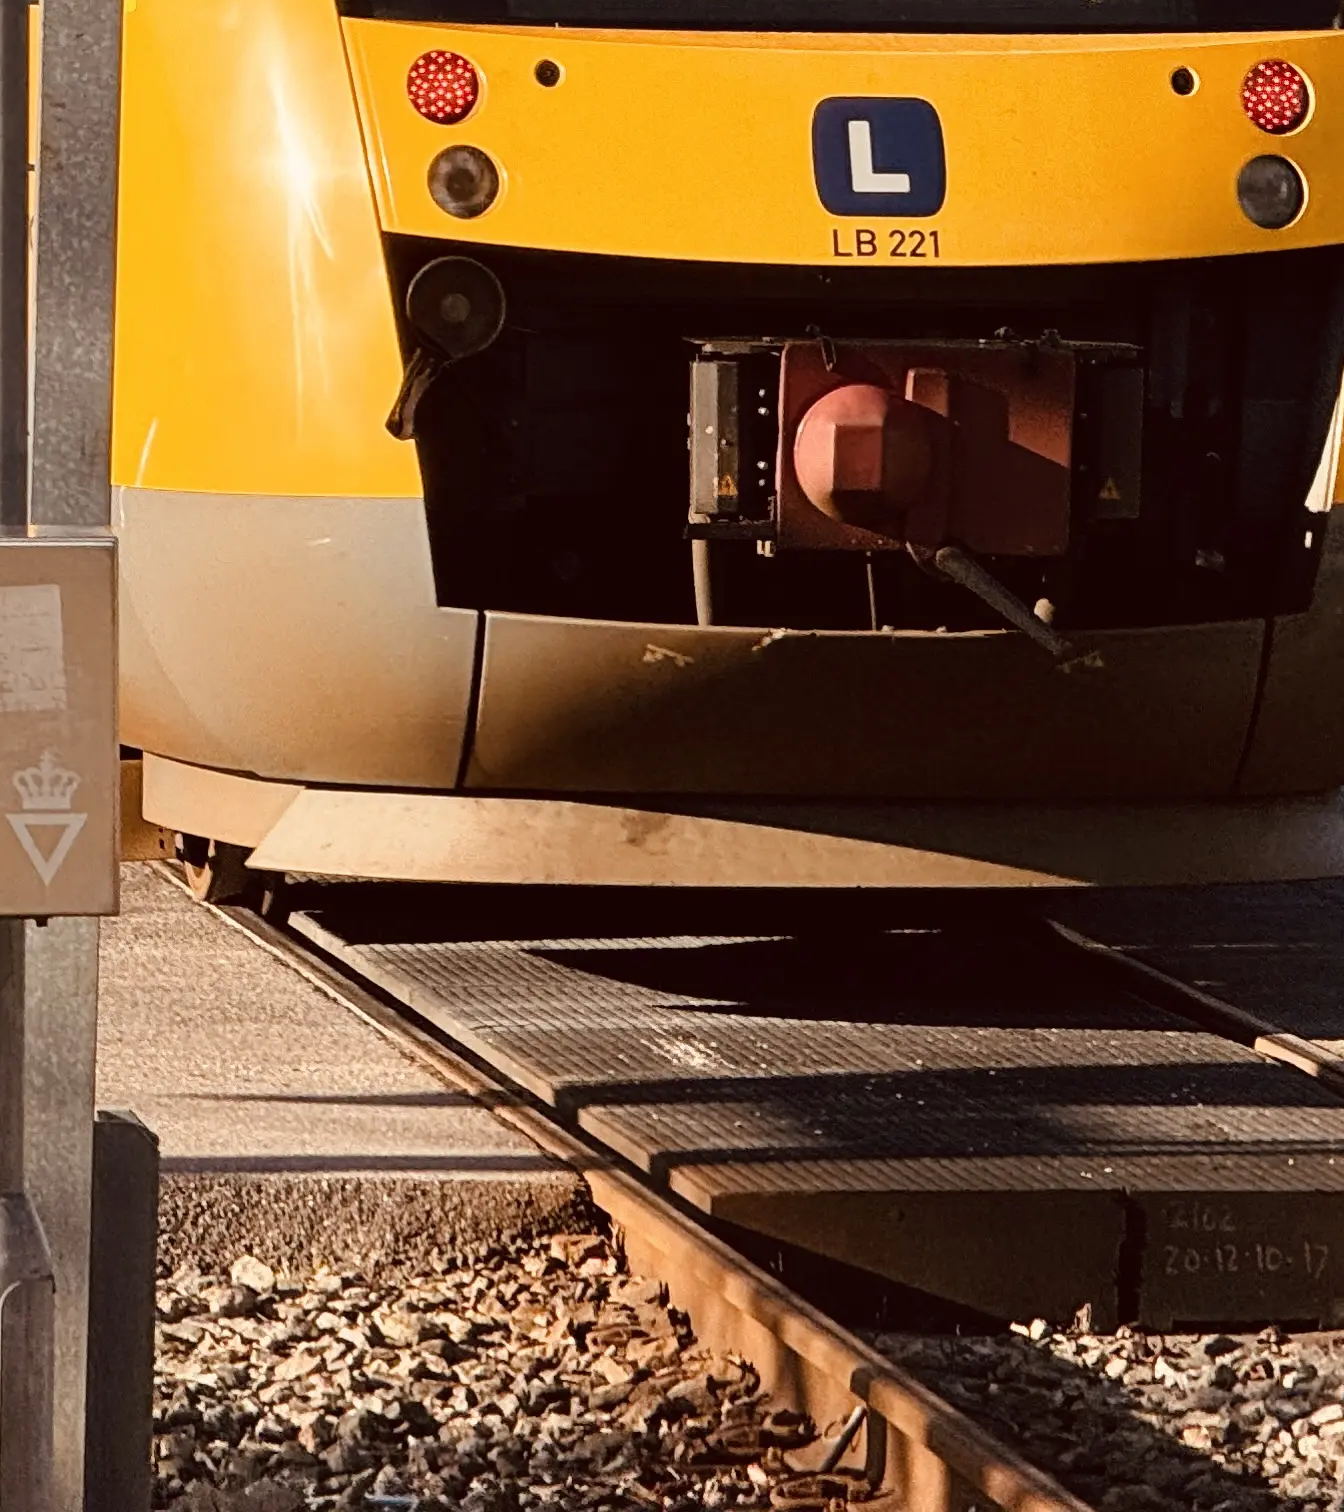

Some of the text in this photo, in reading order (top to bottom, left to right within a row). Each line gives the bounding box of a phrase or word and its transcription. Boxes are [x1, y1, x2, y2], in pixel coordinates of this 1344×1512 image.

[847, 120, 911, 193] L
[831, 229, 941, 259] LB 221
